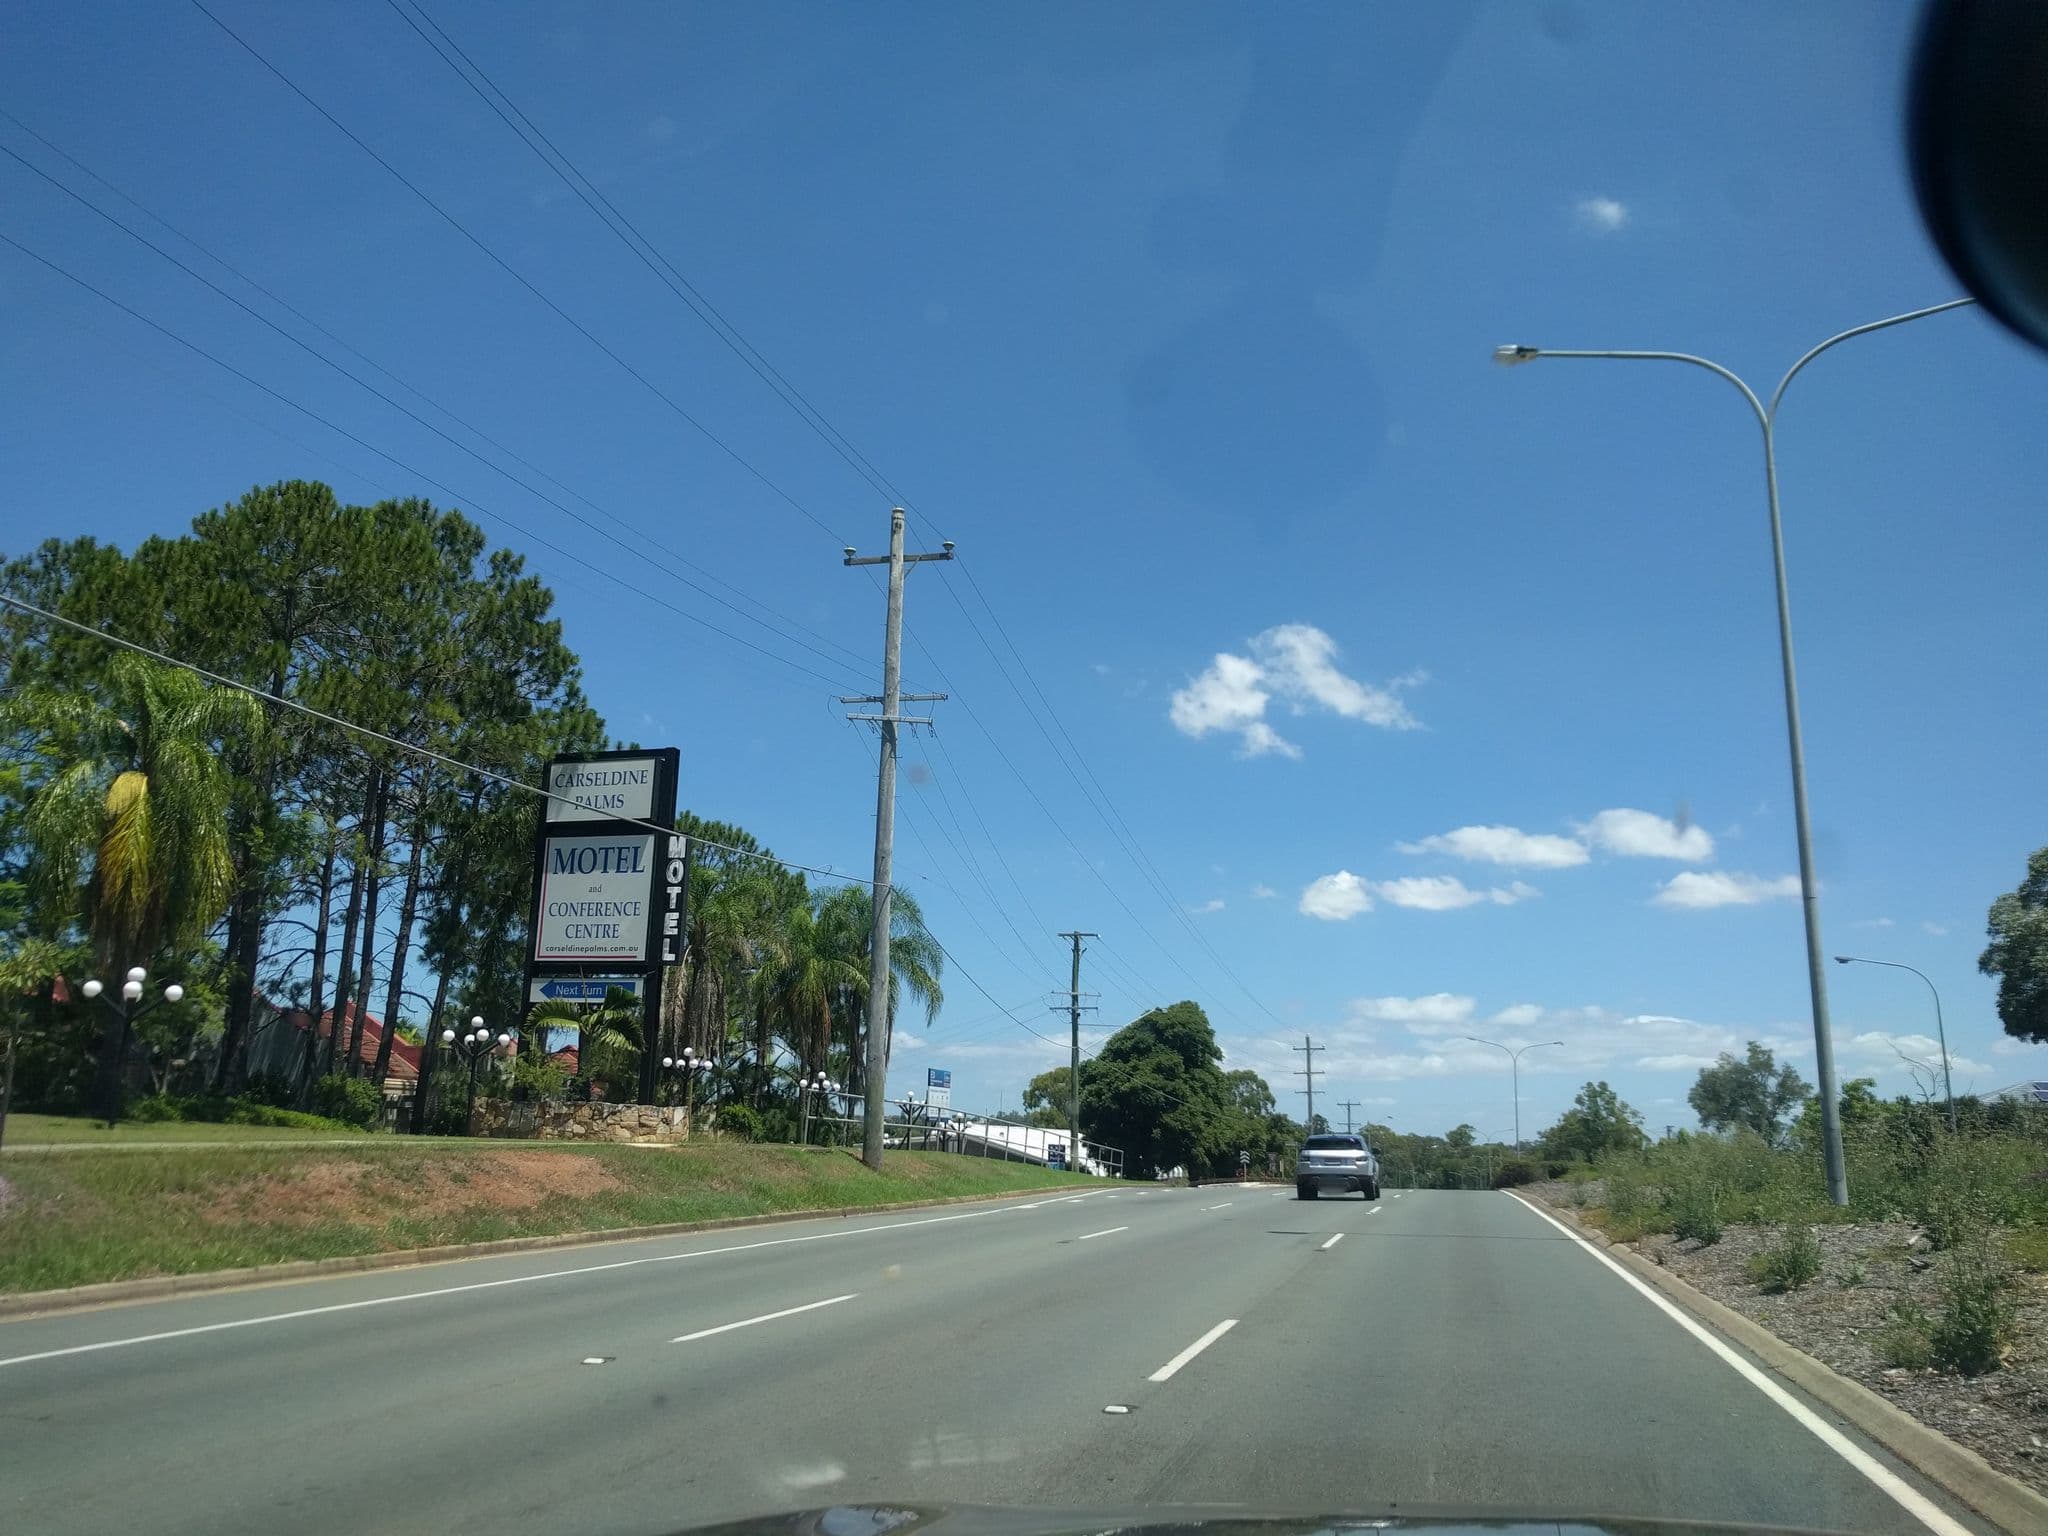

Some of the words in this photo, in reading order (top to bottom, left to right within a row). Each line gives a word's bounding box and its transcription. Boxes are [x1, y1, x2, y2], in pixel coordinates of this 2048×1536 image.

[555, 770, 648, 788] CARSELDINE
[575, 794, 625, 810] PALMS
[553, 847, 645, 874] MOTEL
[588, 884, 602, 893] and
[662, 836, 686, 961] MOTEL
[548, 902, 641, 917] CONFERENCE
[565, 924, 620, 939] CENTRE
[545, 945, 639, 953] carseldinepalms.com.au
[555, 985, 578, 995] Next
